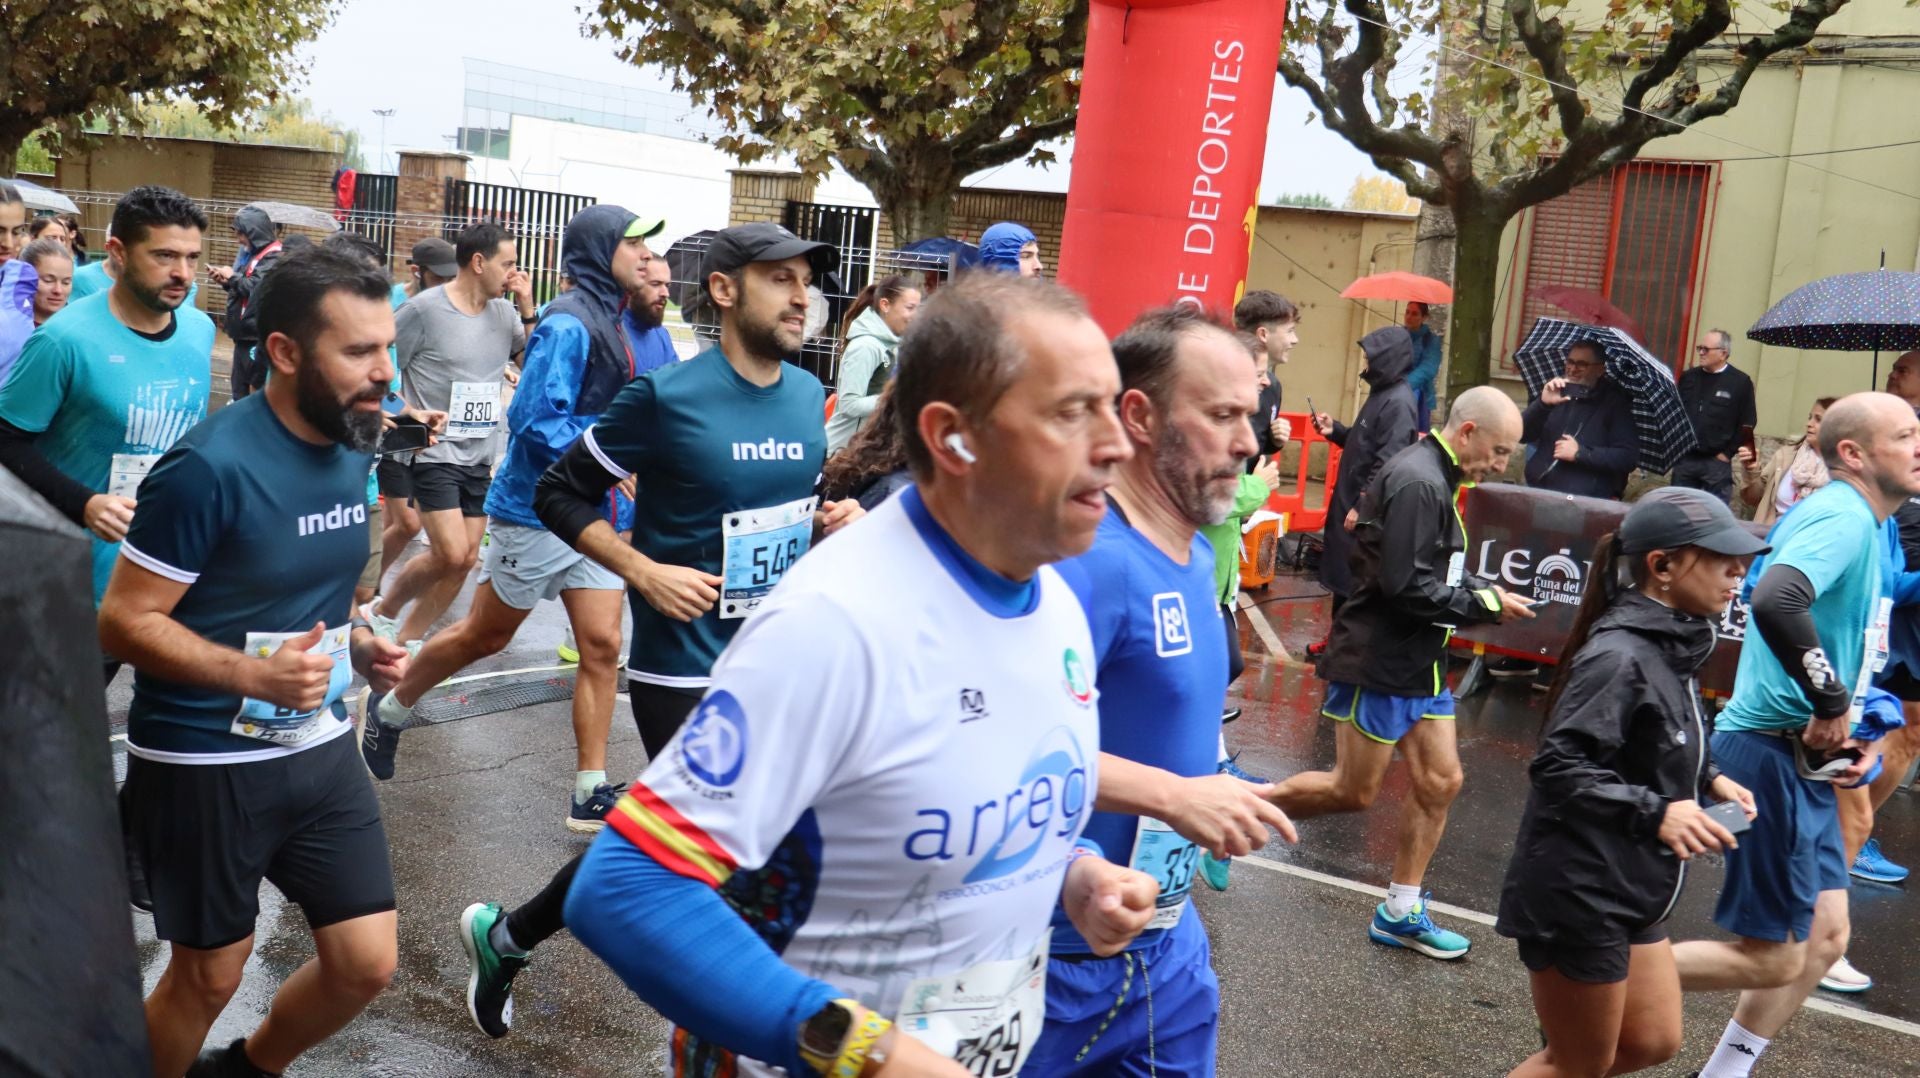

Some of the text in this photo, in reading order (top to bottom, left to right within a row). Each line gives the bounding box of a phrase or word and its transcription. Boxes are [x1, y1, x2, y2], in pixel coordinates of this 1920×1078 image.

[1183, 39, 1245, 255] DEPORTES
[464, 401, 493, 422] 830
[732, 437, 805, 461] indra
[297, 503, 367, 537] indra
[752, 537, 799, 586] 546
[1532, 586, 1582, 606] Parlamen
[1533, 575, 1579, 594] Cuna del
[903, 766, 1096, 862] arreg
